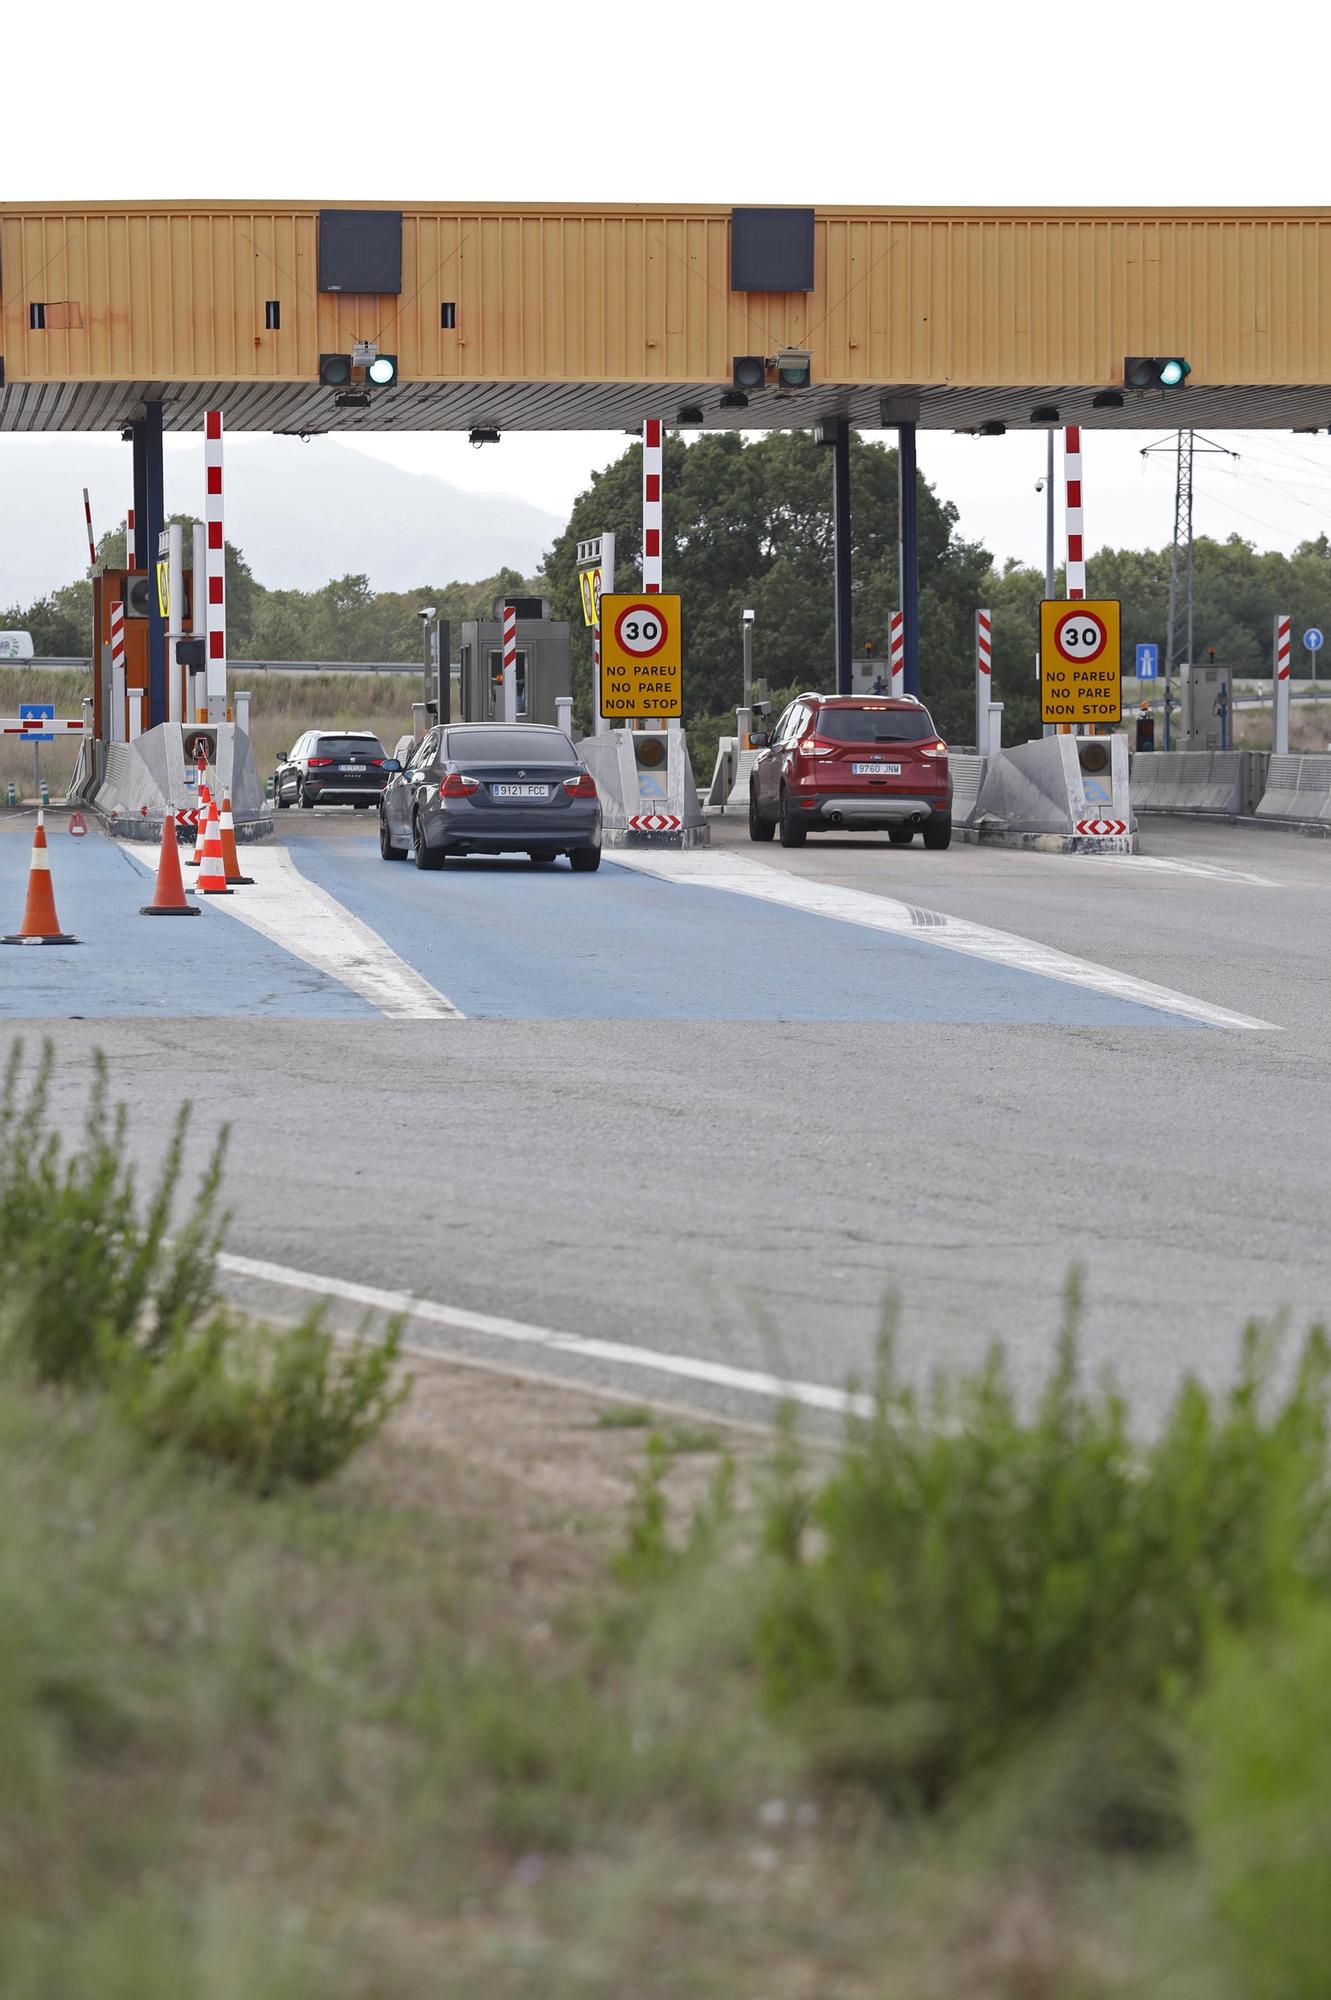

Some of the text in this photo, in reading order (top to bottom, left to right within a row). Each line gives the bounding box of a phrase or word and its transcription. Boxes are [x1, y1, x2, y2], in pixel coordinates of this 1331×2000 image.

[626, 622, 658, 640] 30
[1065, 628, 1097, 646] 30
[607, 666, 676, 676] NO PAREU
[1046, 672, 1115, 682] NO PAREU
[611, 683, 672, 692] NO PARE
[1051, 688, 1111, 698] NO PARE
[605, 699, 677, 709] NON STOP
[1046, 705, 1117, 715] NON STOP
[501, 785, 545, 795] 9121 FCC
